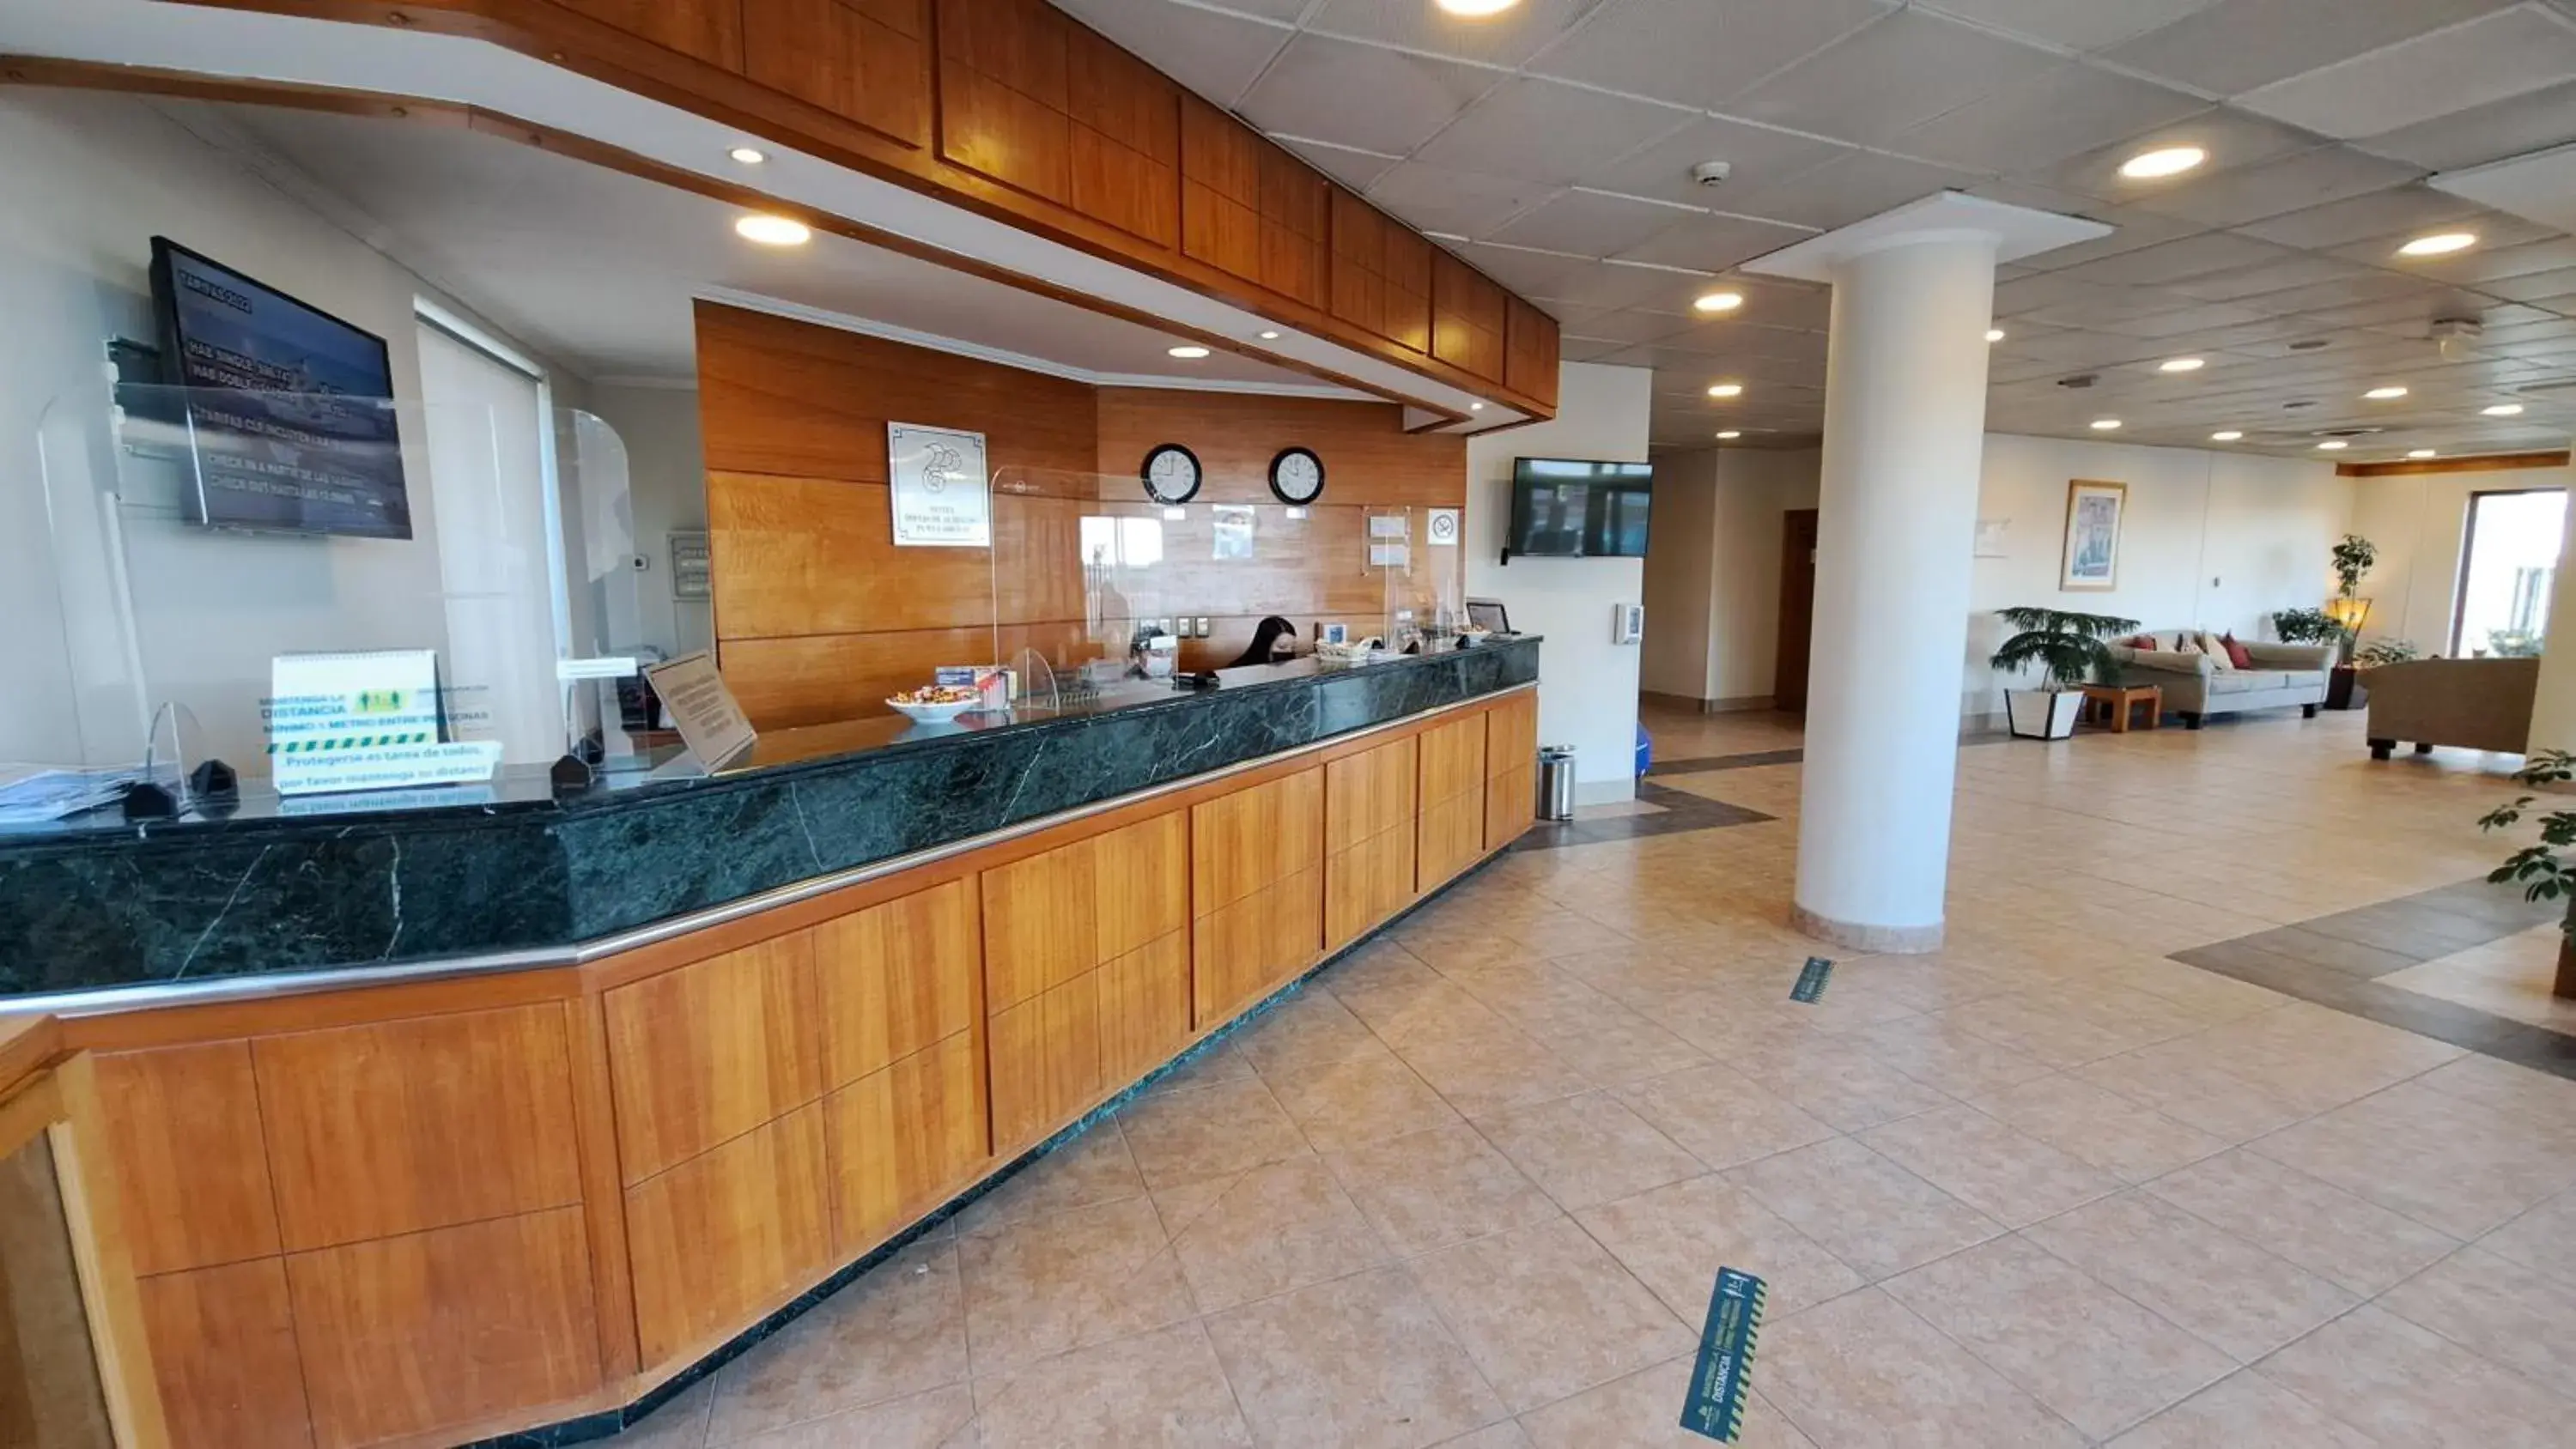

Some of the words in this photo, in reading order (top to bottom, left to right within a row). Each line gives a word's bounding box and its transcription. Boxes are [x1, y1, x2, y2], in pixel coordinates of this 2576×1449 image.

[260, 704, 347, 719] DISTANCIA
[286, 754, 362, 767] Protegerse
[384, 750, 420, 761] tarea
[423, 747, 440, 758] de
[1712, 1355, 1732, 1404] DISTANCIA
